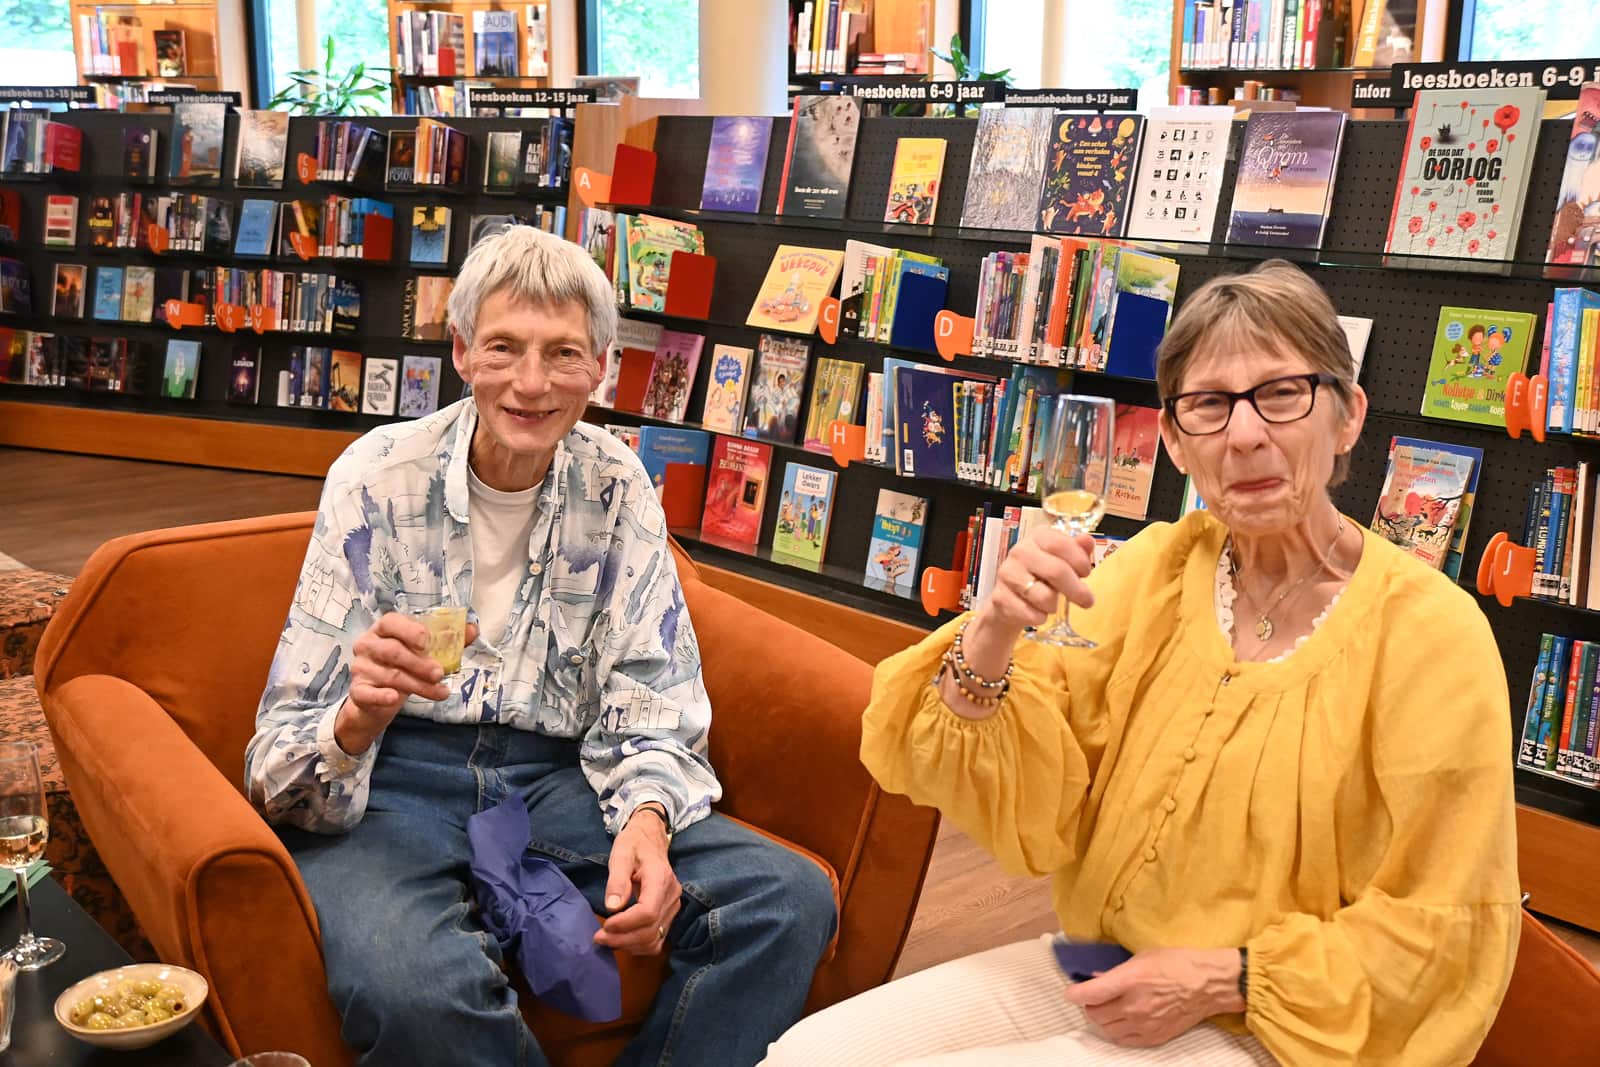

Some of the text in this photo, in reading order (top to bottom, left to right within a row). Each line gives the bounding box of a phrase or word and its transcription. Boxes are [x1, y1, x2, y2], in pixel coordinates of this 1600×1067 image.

[1402, 69, 1533, 89] leesboeken
[1542, 66, 1585, 87] 6-9
[0, 88, 88, 102] eesboeken 12-15 jaar
[470, 91, 590, 105] leesboeken 12-15 jaar
[853, 84, 926, 99] leesboeken
[930, 84, 953, 98] 6-9
[956, 84, 985, 102] jaar
[1005, 93, 1084, 104] informatieboeken
[1108, 94, 1129, 107] jaar
[1423, 157, 1502, 181] OORLOG
[579, 172, 591, 189] A
[169, 303, 181, 317] N
[255, 305, 262, 317] U
[824, 304, 836, 324] C
[255, 318, 262, 329] V
[939, 316, 953, 337] D
[1513, 380, 1523, 408] E
[1535, 383, 1544, 409] F
[833, 424, 845, 444] H
[802, 471, 822, 482] Lekker
[1502, 549, 1513, 577] J
[927, 573, 935, 593] L
